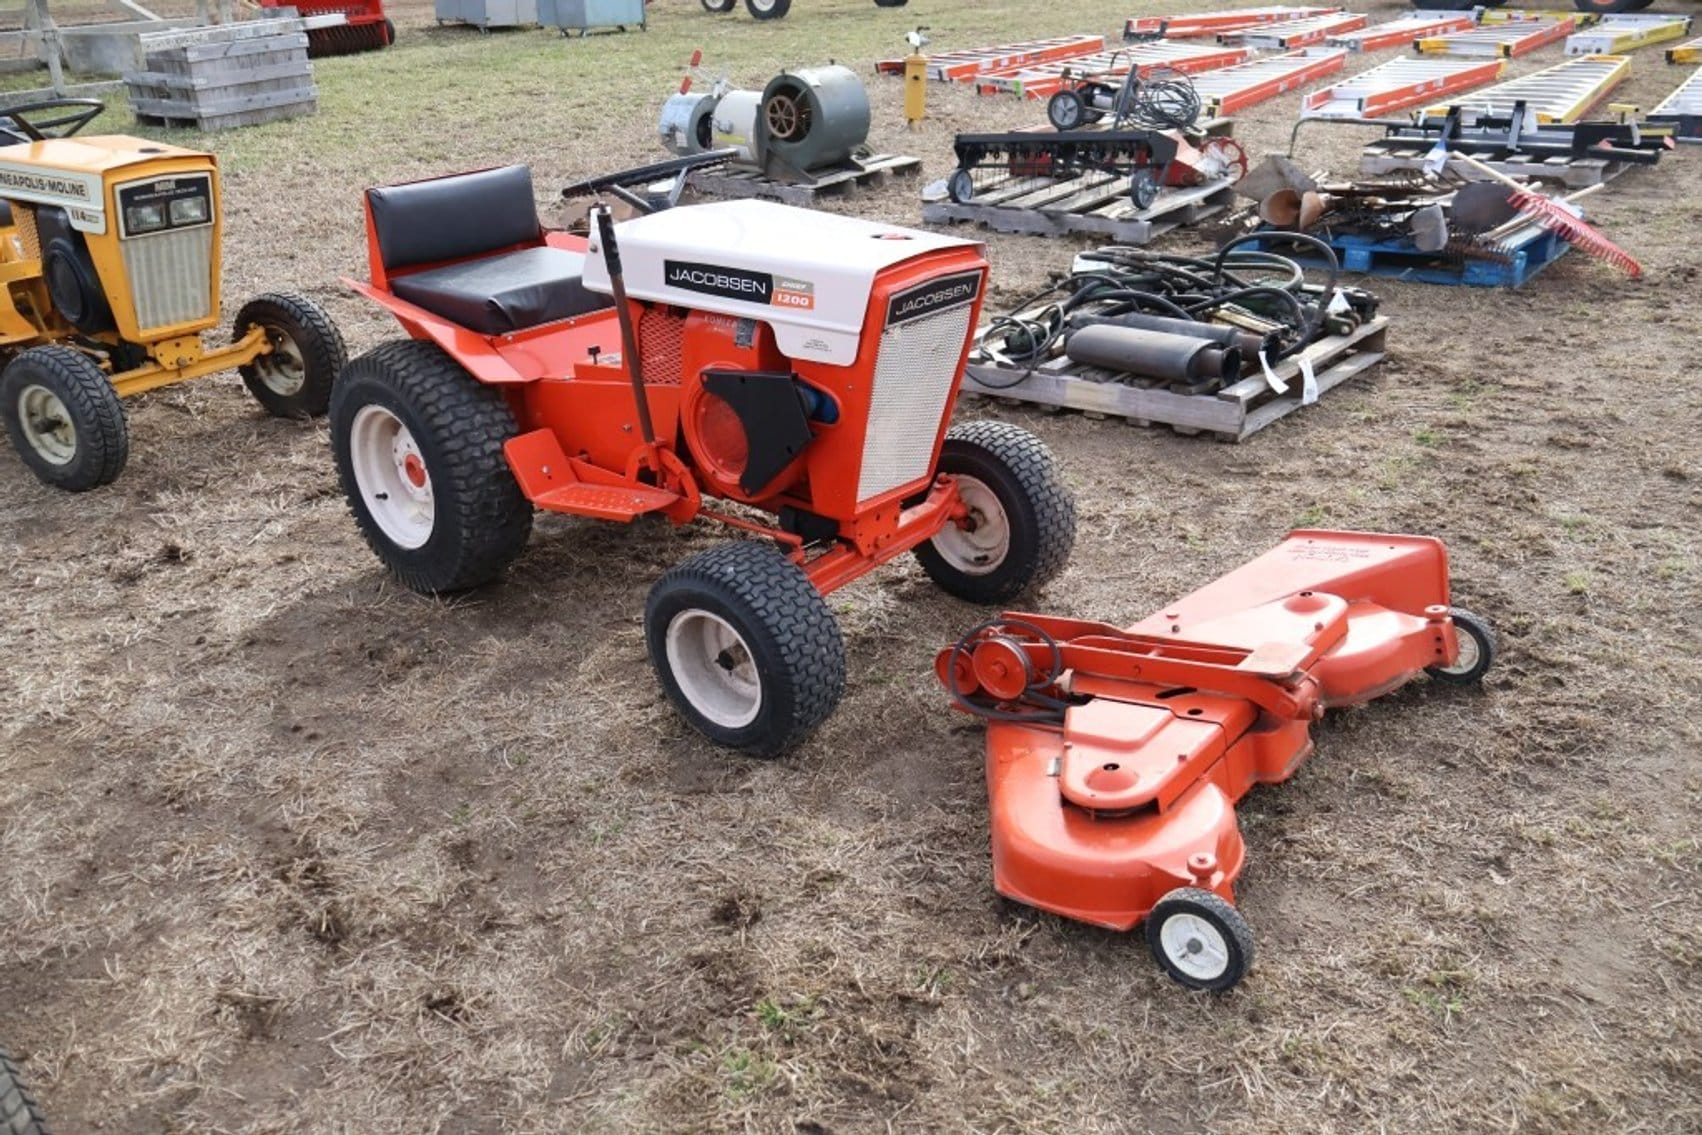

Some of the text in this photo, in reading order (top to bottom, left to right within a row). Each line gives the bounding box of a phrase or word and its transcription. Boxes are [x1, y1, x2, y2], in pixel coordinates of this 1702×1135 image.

[669, 268, 767, 295] JACOBSEN
[777, 293, 810, 307] 1200
[896, 282, 974, 316] JACOBSEN
